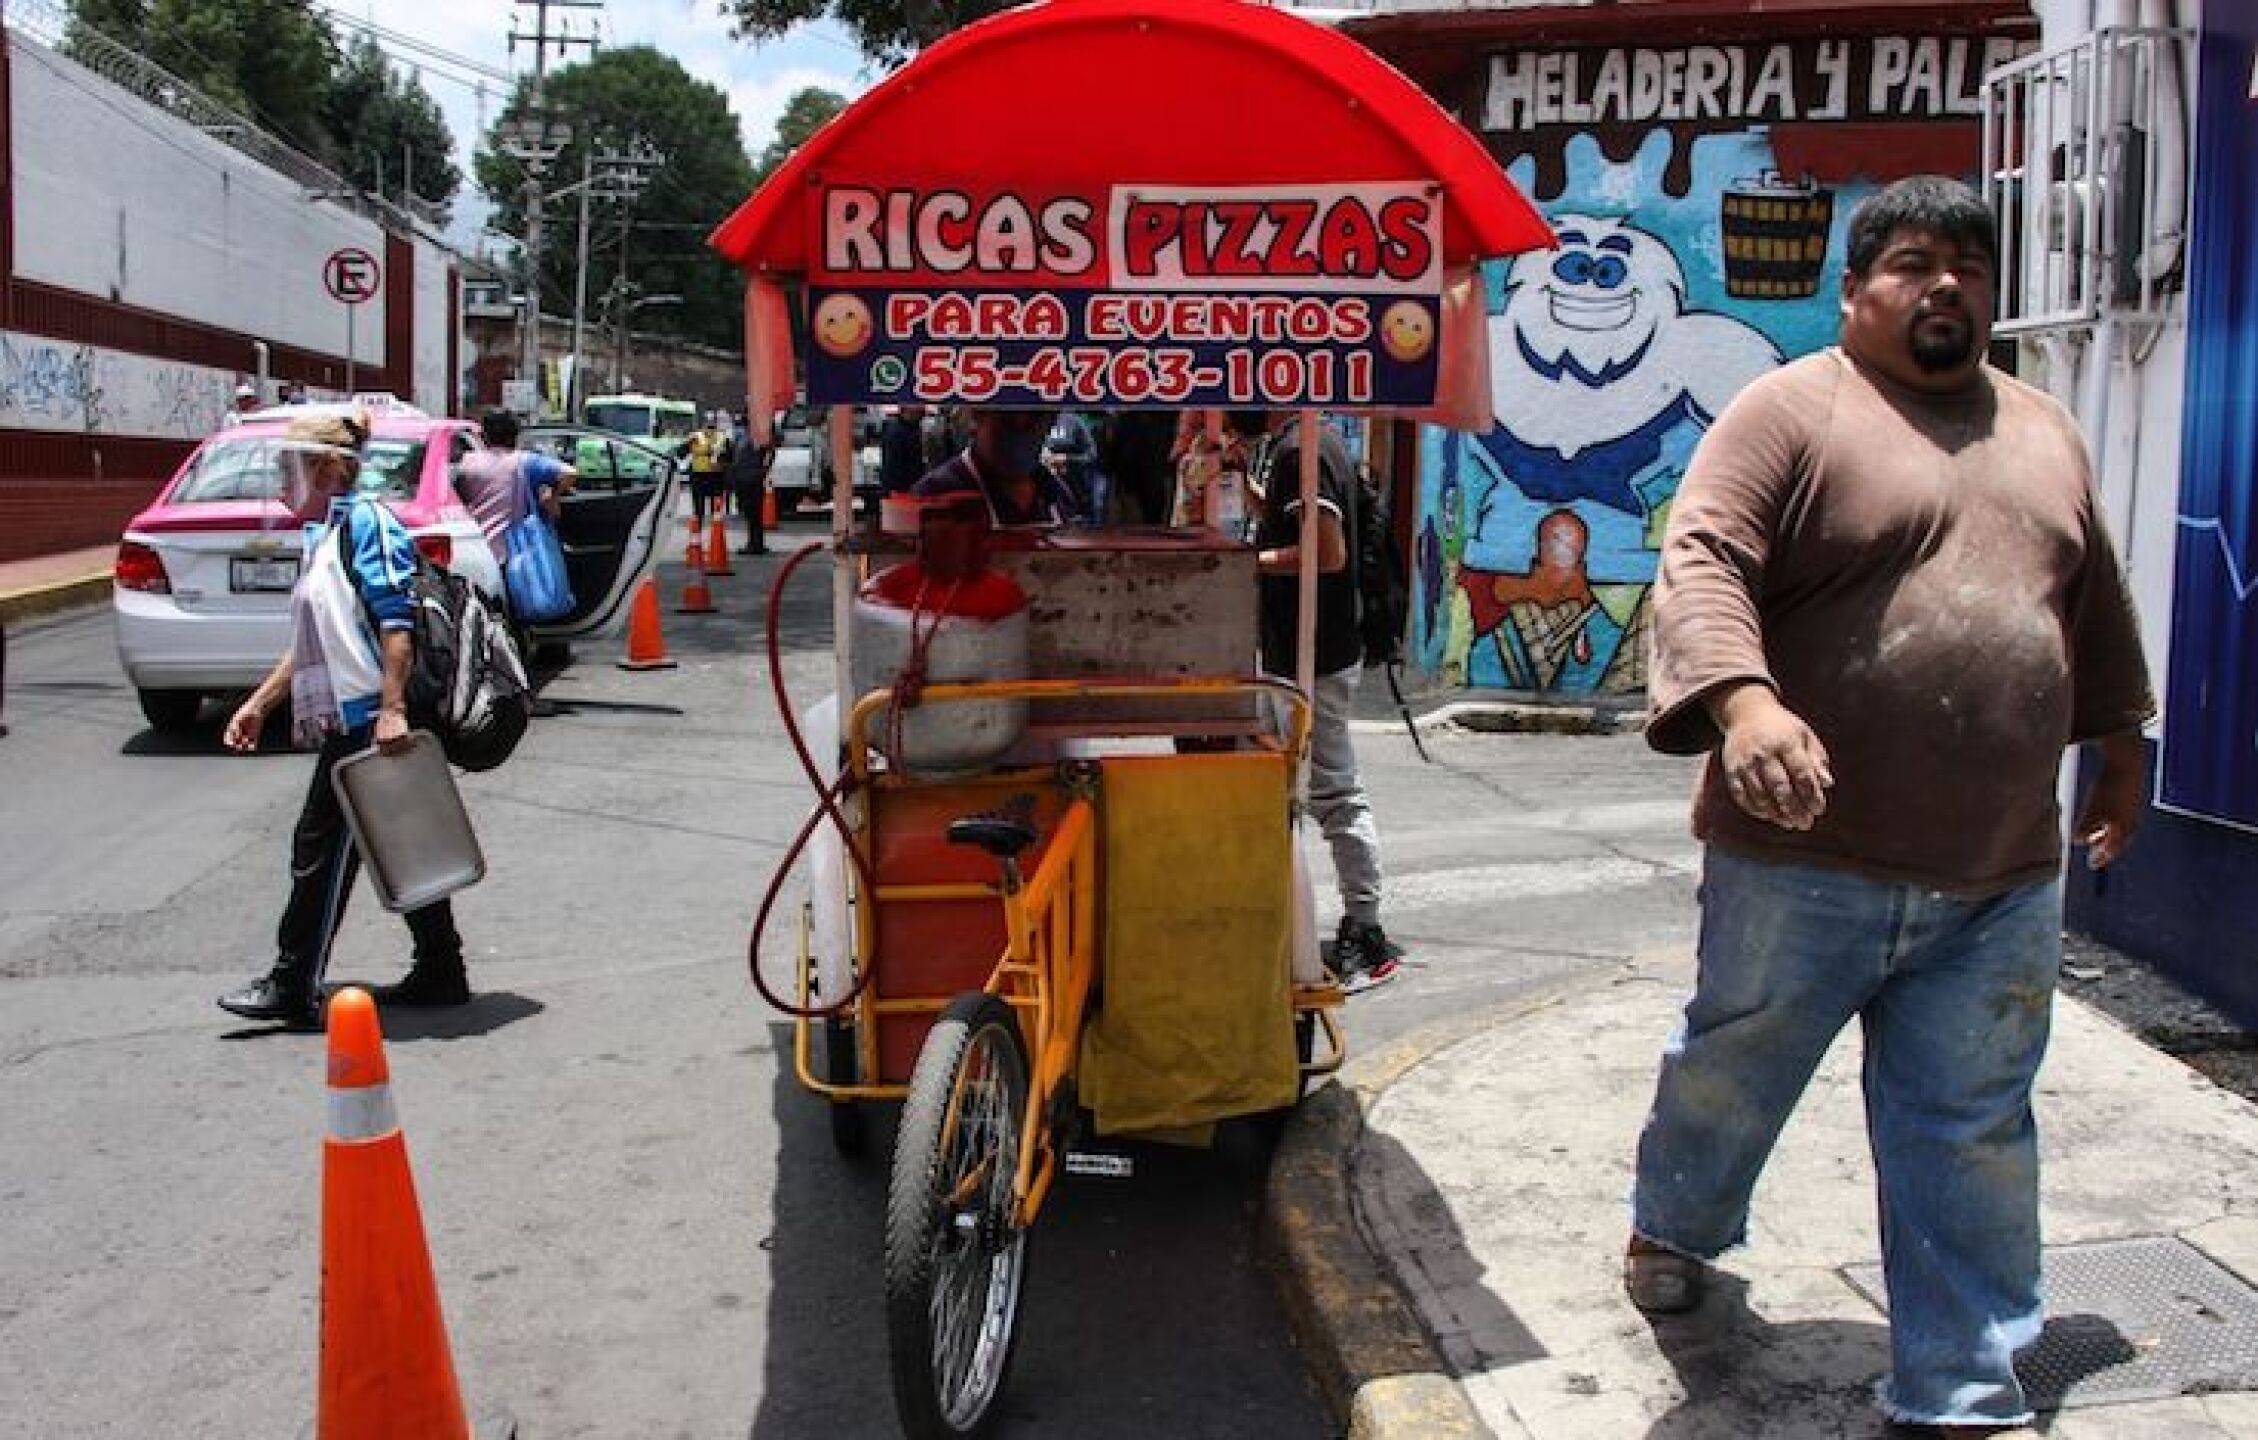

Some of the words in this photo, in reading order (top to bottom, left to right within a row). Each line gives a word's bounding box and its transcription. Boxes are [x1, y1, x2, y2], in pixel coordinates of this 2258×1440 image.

[1483, 44, 1796, 131] HELADERIA
[825, 184, 1096, 274] RICAS
[1123, 195, 1432, 281] PIZZAS
[885, 290, 1069, 340] PARA
[1085, 294, 1373, 341] EVENTOS
[914, 346, 1373, 402] 55-4763-1011
